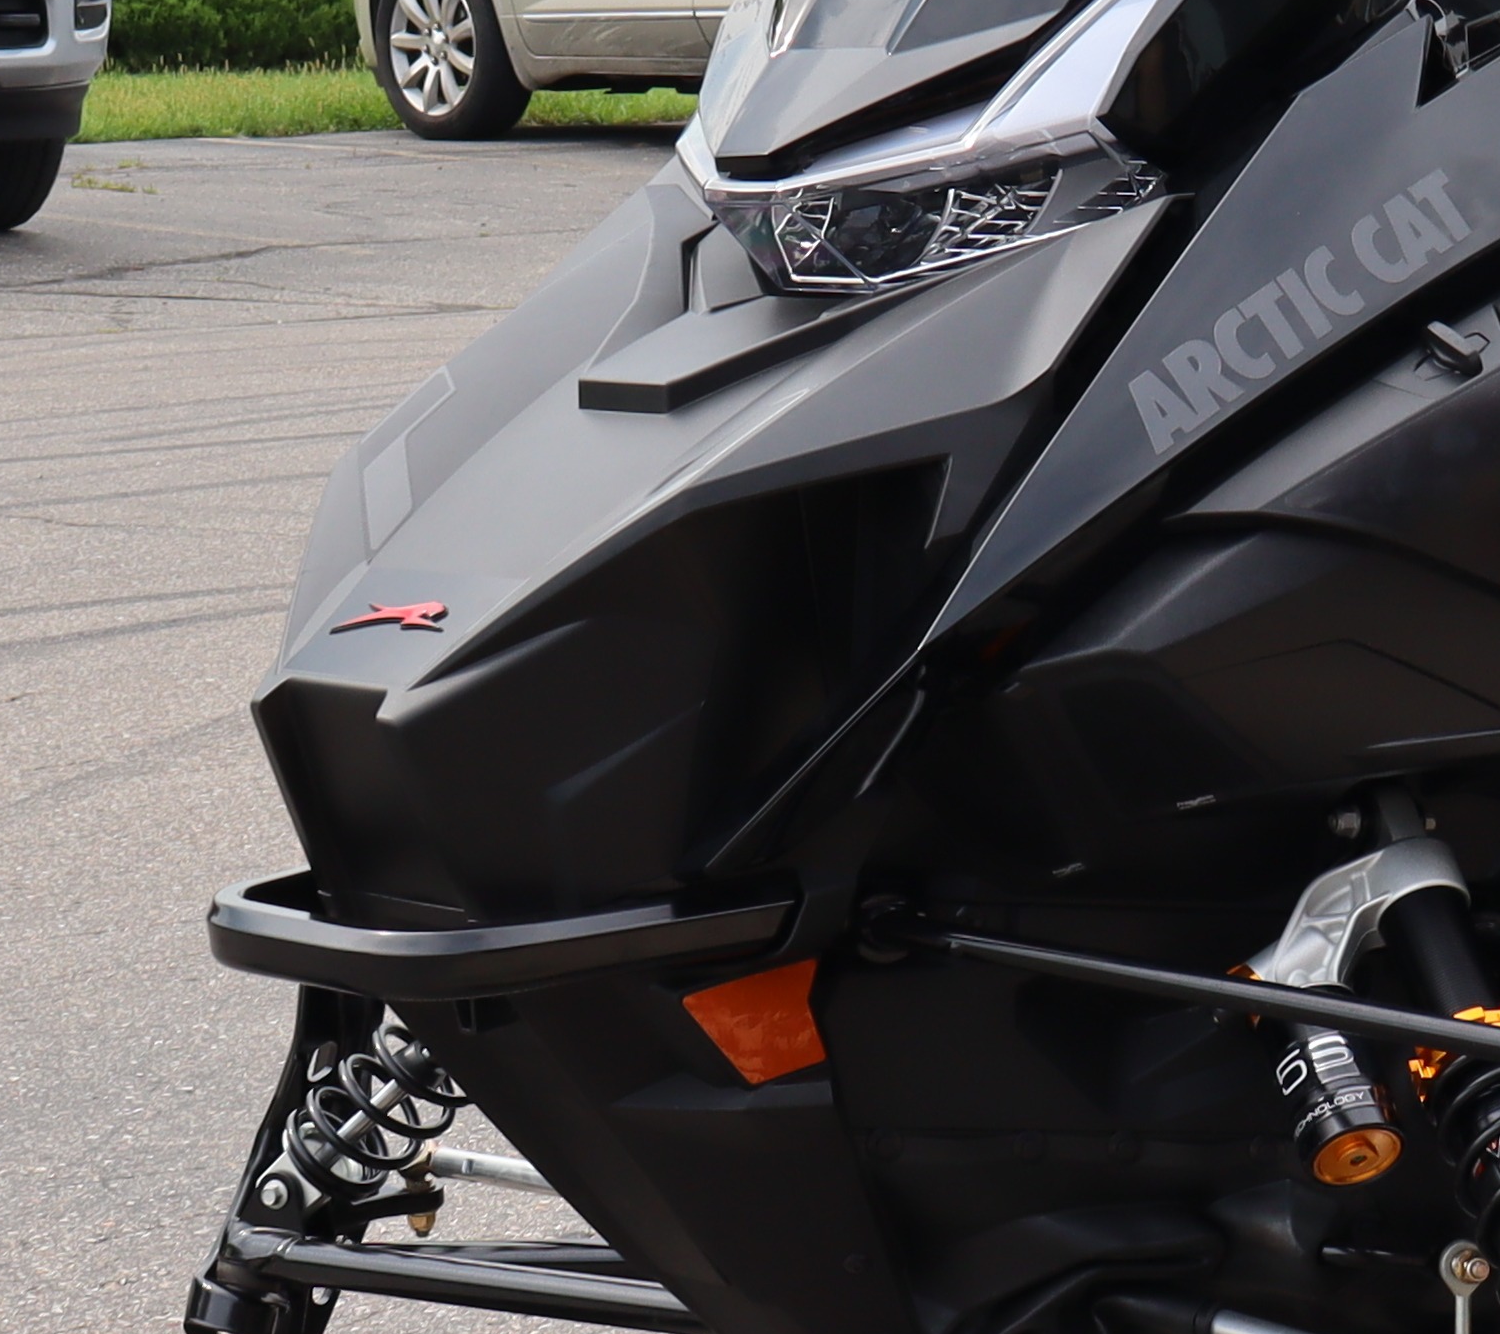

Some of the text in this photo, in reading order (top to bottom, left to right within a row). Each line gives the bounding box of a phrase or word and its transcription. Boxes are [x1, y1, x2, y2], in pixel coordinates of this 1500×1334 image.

[1128, 167, 1477, 455] ARCTIC CAT
[1294, 1091, 1364, 1141] CHNOLOGY
